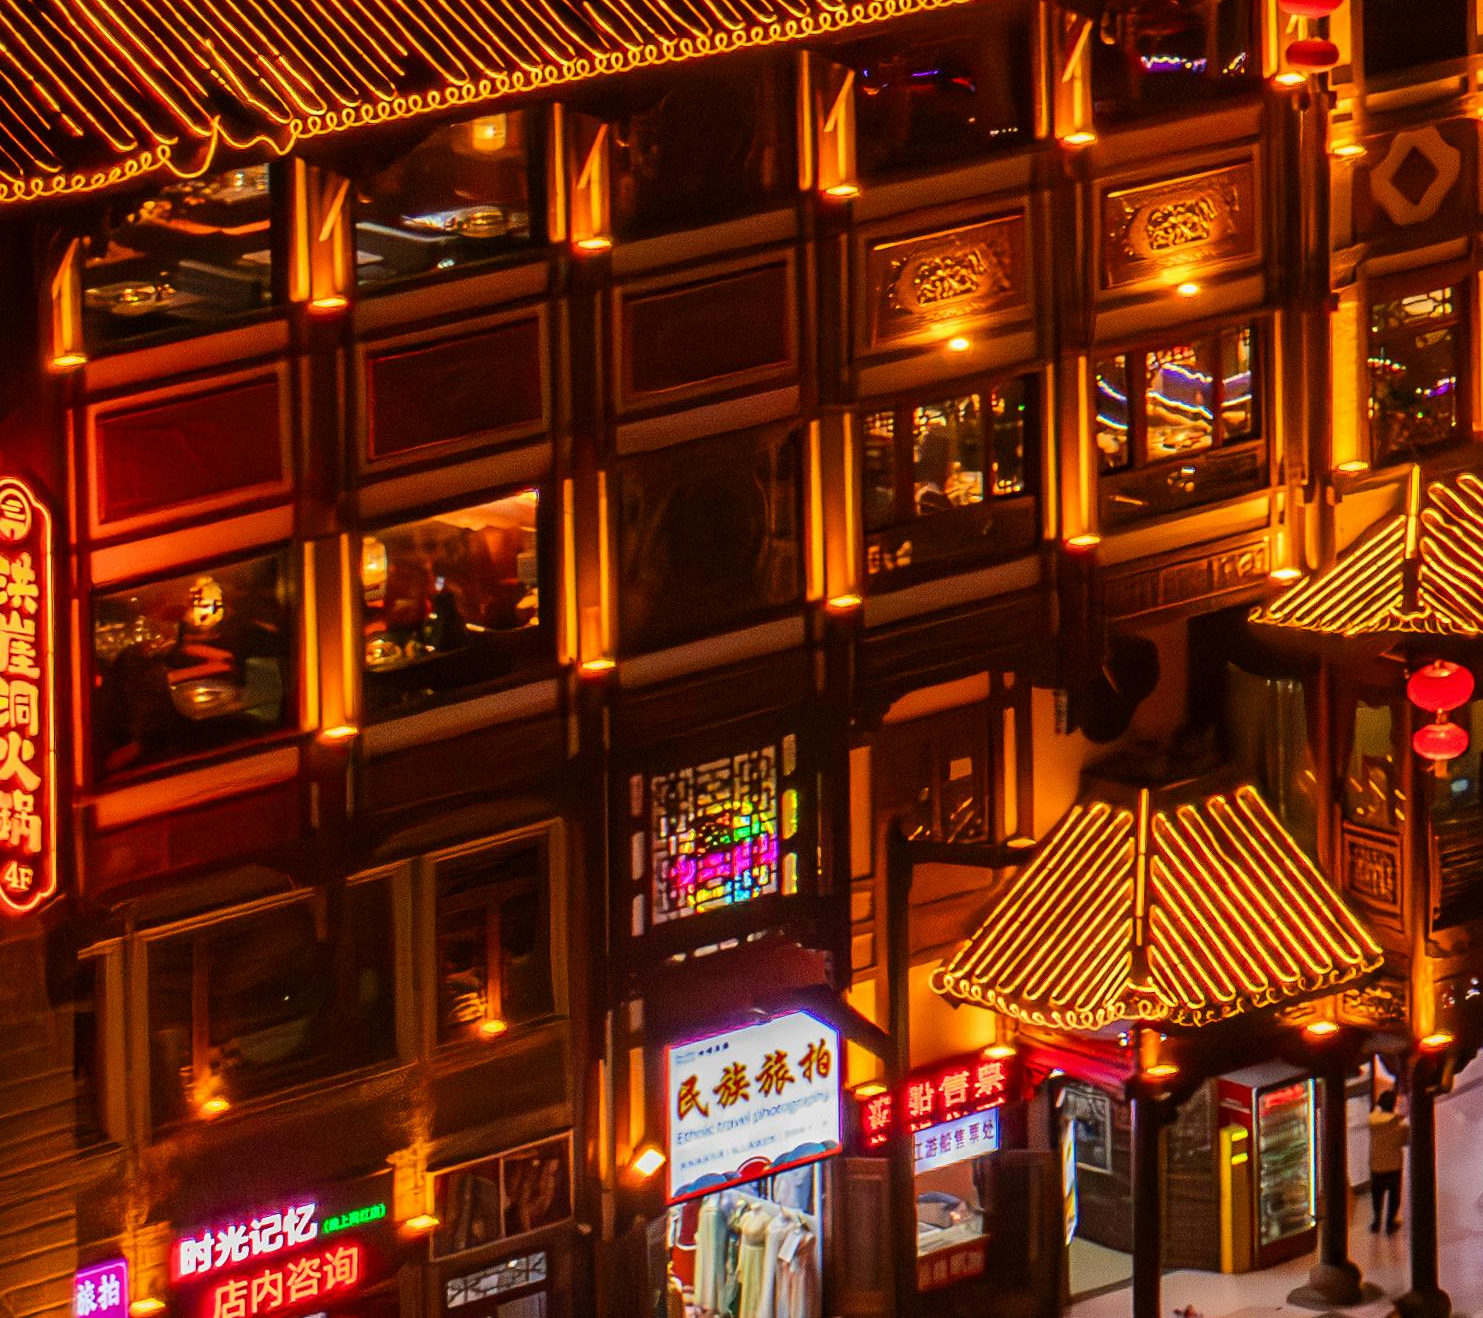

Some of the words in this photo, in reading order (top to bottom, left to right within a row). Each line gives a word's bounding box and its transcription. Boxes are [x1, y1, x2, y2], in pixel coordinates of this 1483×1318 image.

[4, 860, 33, 892] 4F
[677, 1038, 831, 1121] 民族旅拍
[179, 1203, 318, 1276] 时光记忆
[213, 1247, 359, 1318] 店内咨询
